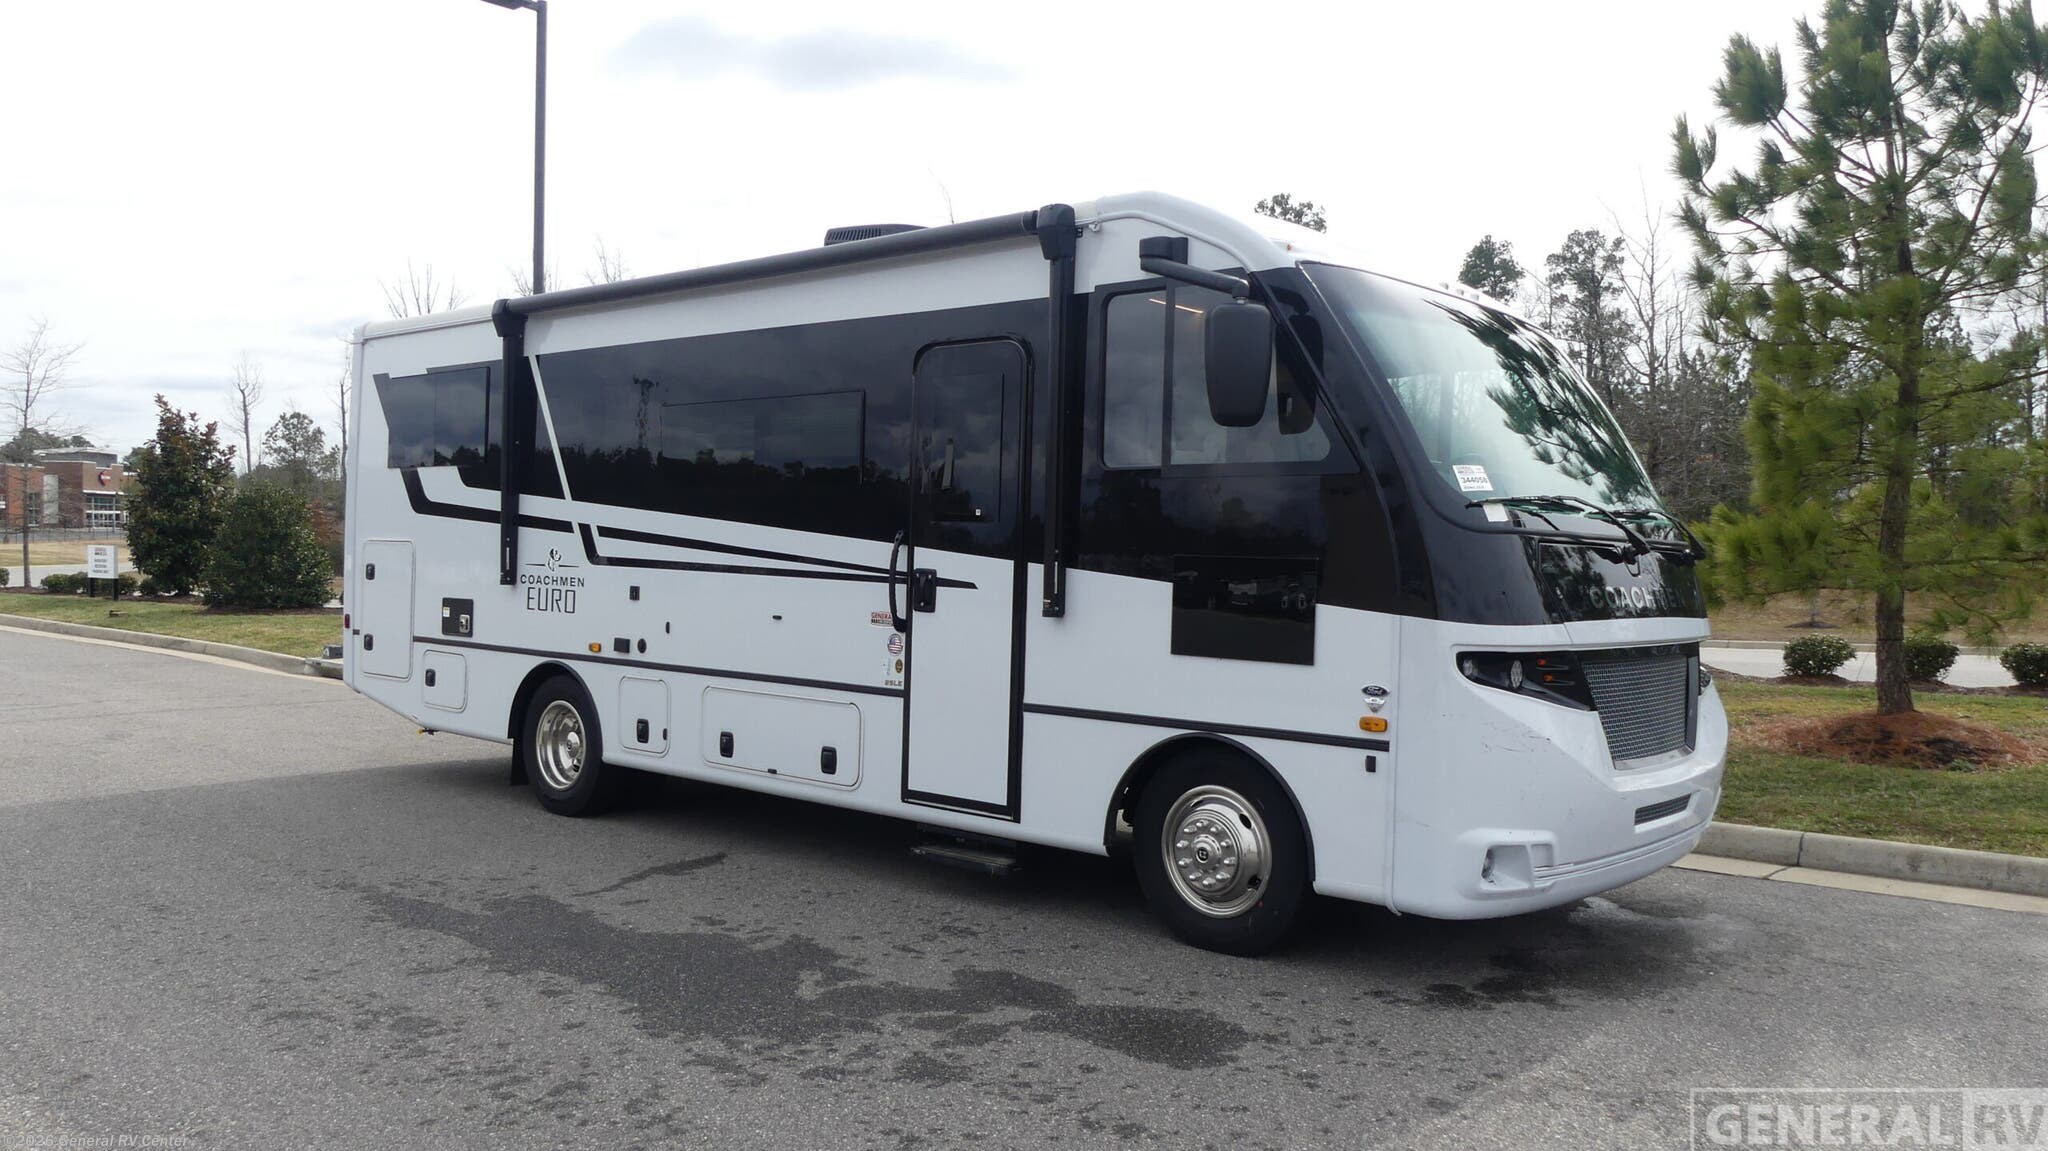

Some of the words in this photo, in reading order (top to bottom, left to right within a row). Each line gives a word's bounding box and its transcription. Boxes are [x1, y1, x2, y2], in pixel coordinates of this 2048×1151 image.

[520, 574, 585, 588] COACHMEN
[527, 586, 576, 614] EURO
[871, 611, 892, 620] GENERA
